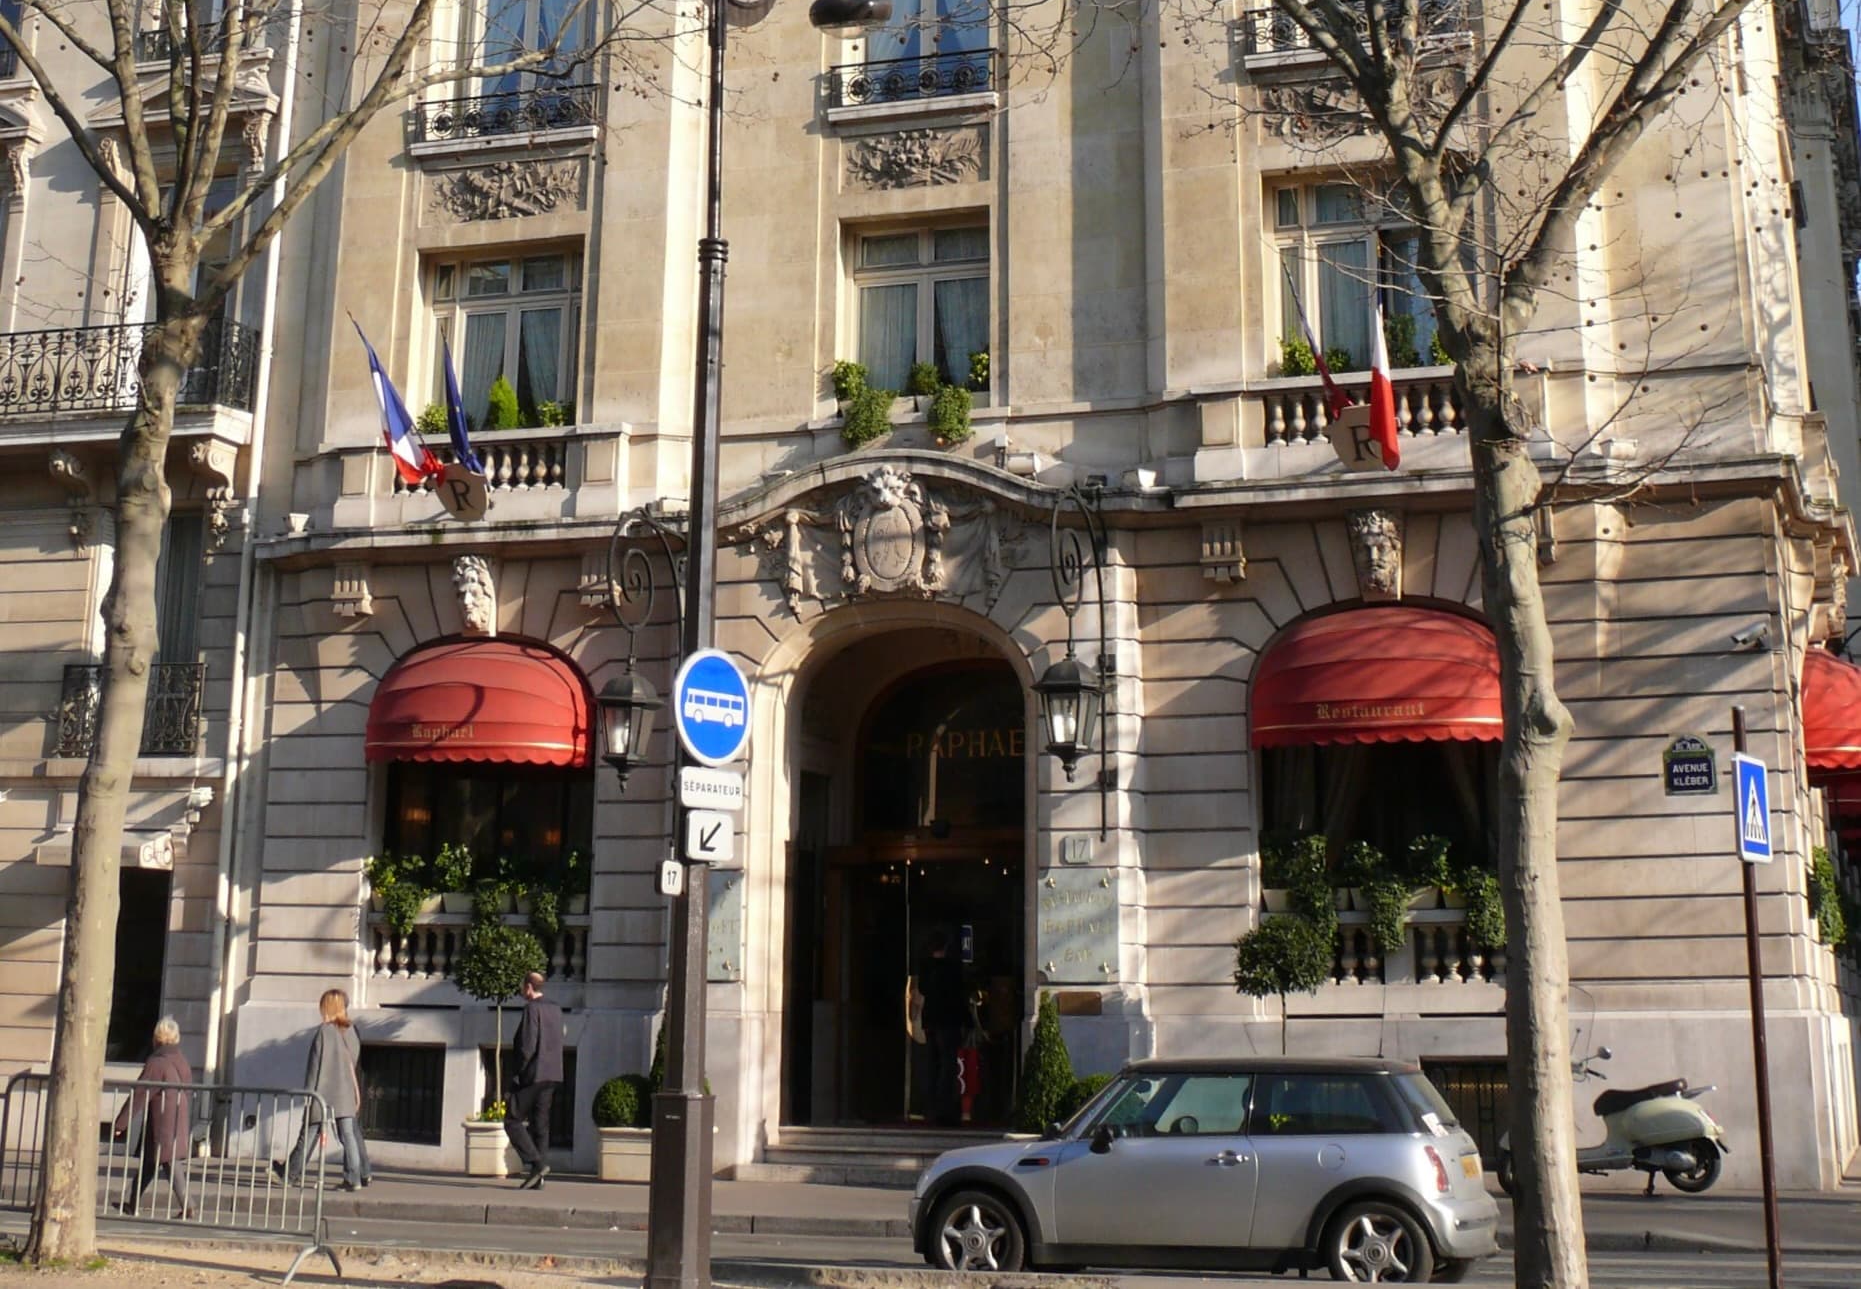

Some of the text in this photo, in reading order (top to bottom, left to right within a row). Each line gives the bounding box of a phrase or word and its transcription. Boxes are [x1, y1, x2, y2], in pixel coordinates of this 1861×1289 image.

[449, 479, 474, 511] R
[1316, 702, 1425, 719] Restaurant
[411, 724, 474, 741] Raphael
[1673, 763, 1709, 773] AVENUE
[683, 781, 741, 797] SÉPARATEUR
[1673, 775, 1709, 786] KLÉBER
[1072, 839, 1088, 860] 17
[666, 870, 677, 887] 17
